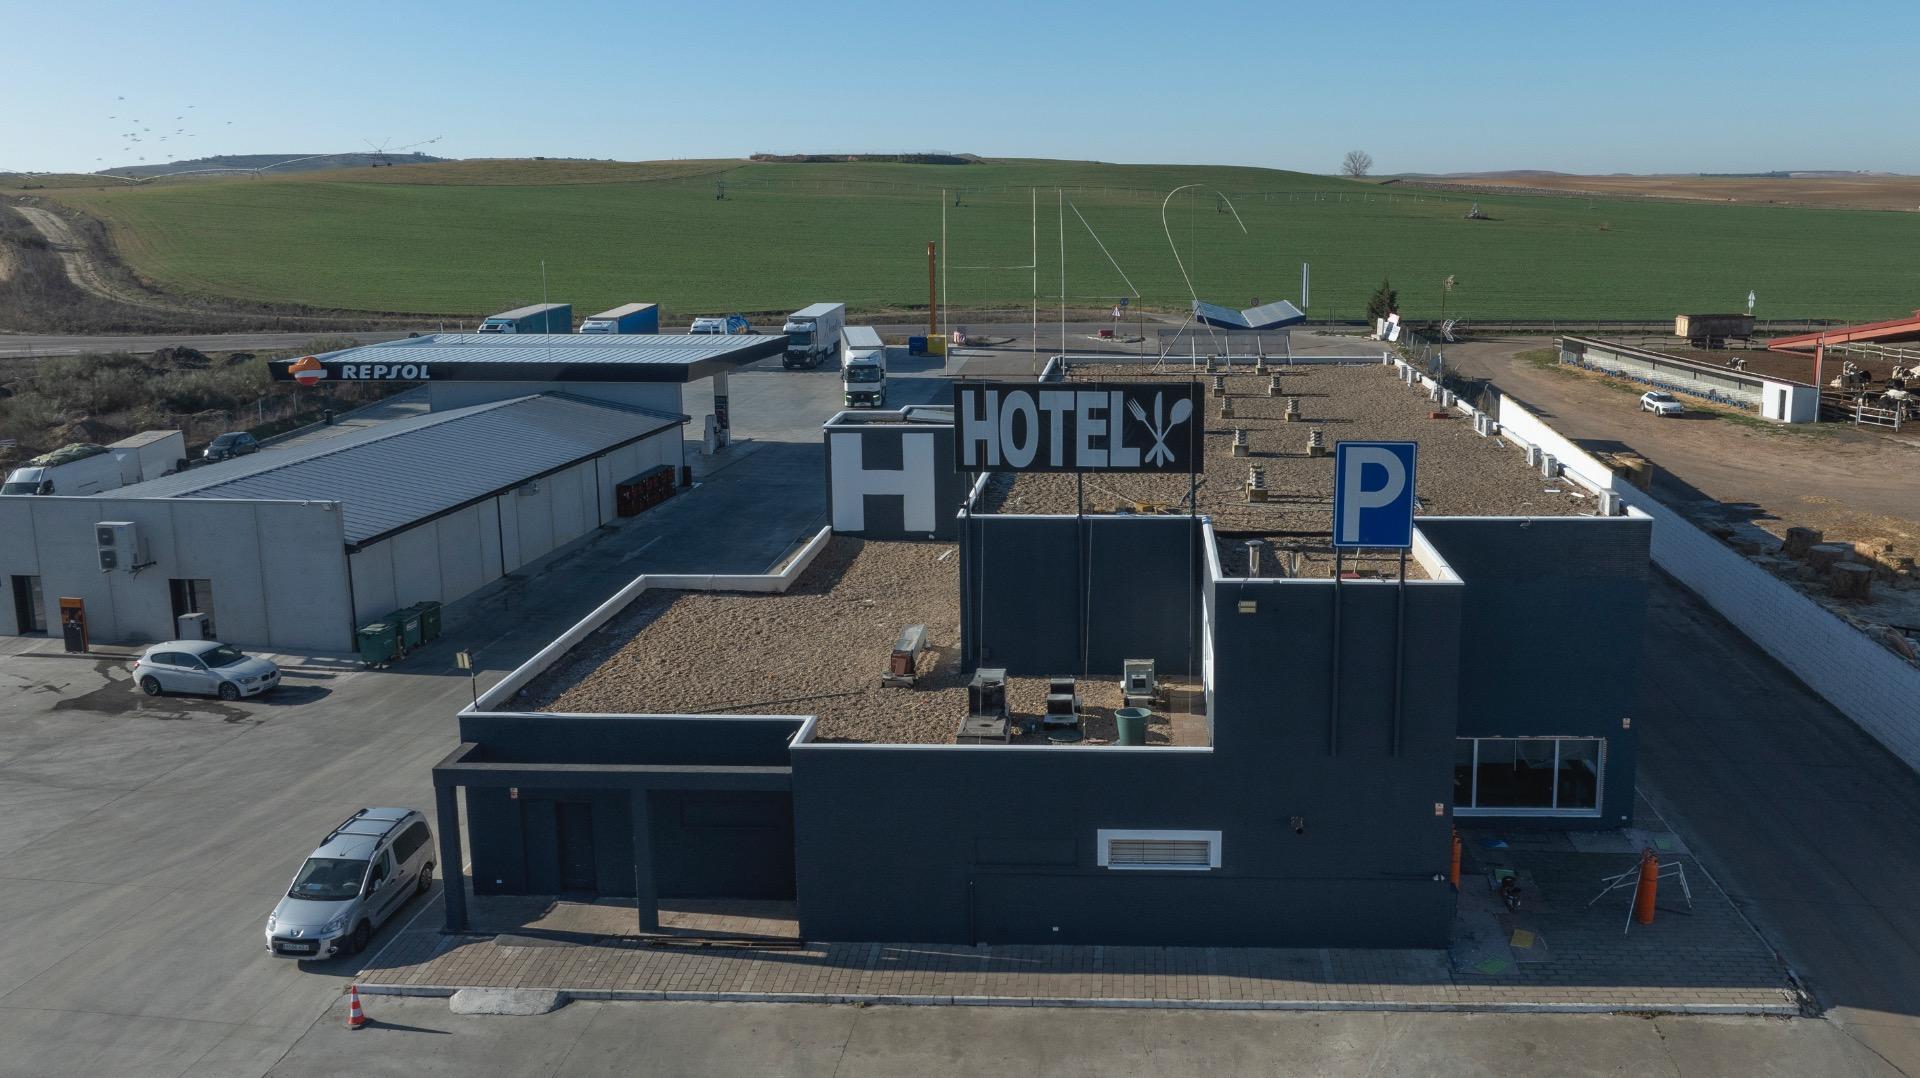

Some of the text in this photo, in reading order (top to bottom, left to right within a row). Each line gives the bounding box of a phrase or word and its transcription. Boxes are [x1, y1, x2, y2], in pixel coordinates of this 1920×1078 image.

[342, 365, 430, 379] REPSOL
[961, 390, 1140, 468] HOTEL
[830, 433, 936, 531] H
[1342, 447, 1406, 542] P
